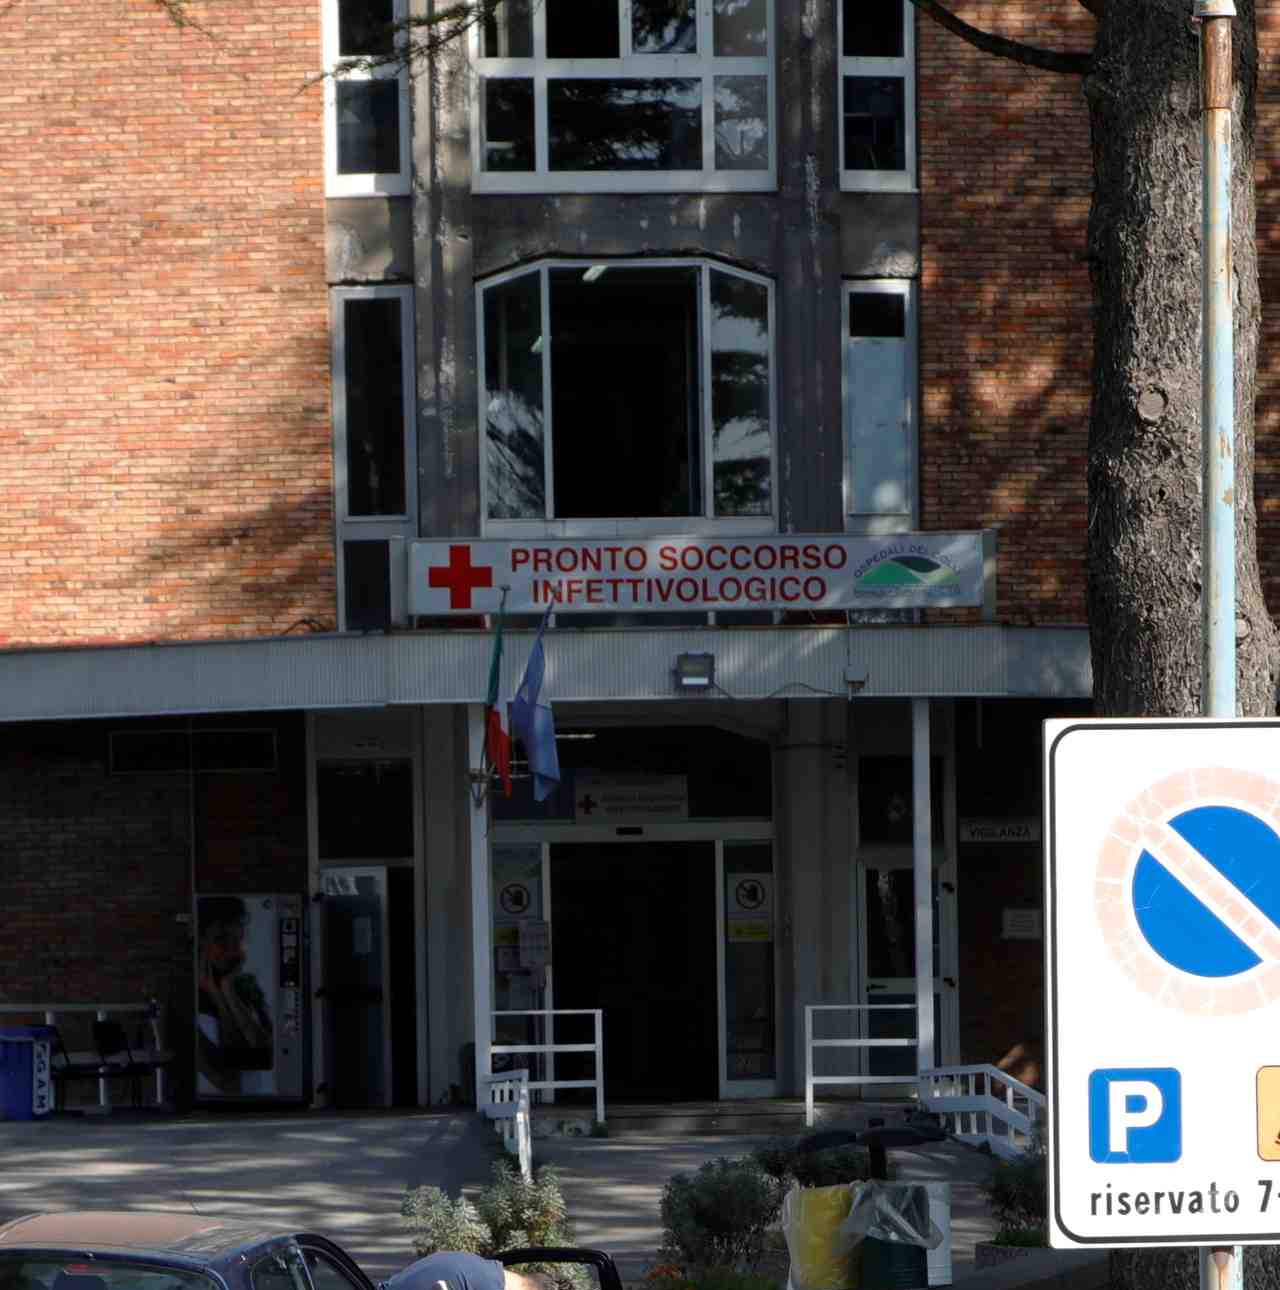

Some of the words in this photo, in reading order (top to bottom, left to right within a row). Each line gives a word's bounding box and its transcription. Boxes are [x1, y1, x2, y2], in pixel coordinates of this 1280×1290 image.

[510, 546, 648, 573] PRONTO
[657, 543, 849, 572] SOCCORSO
[854, 543, 906, 578] OSPEDALI
[531, 575, 828, 605] INFETTIVOLOGICO
[1108, 1080, 1165, 1153] P
[1090, 1182, 1240, 1216] riservato
